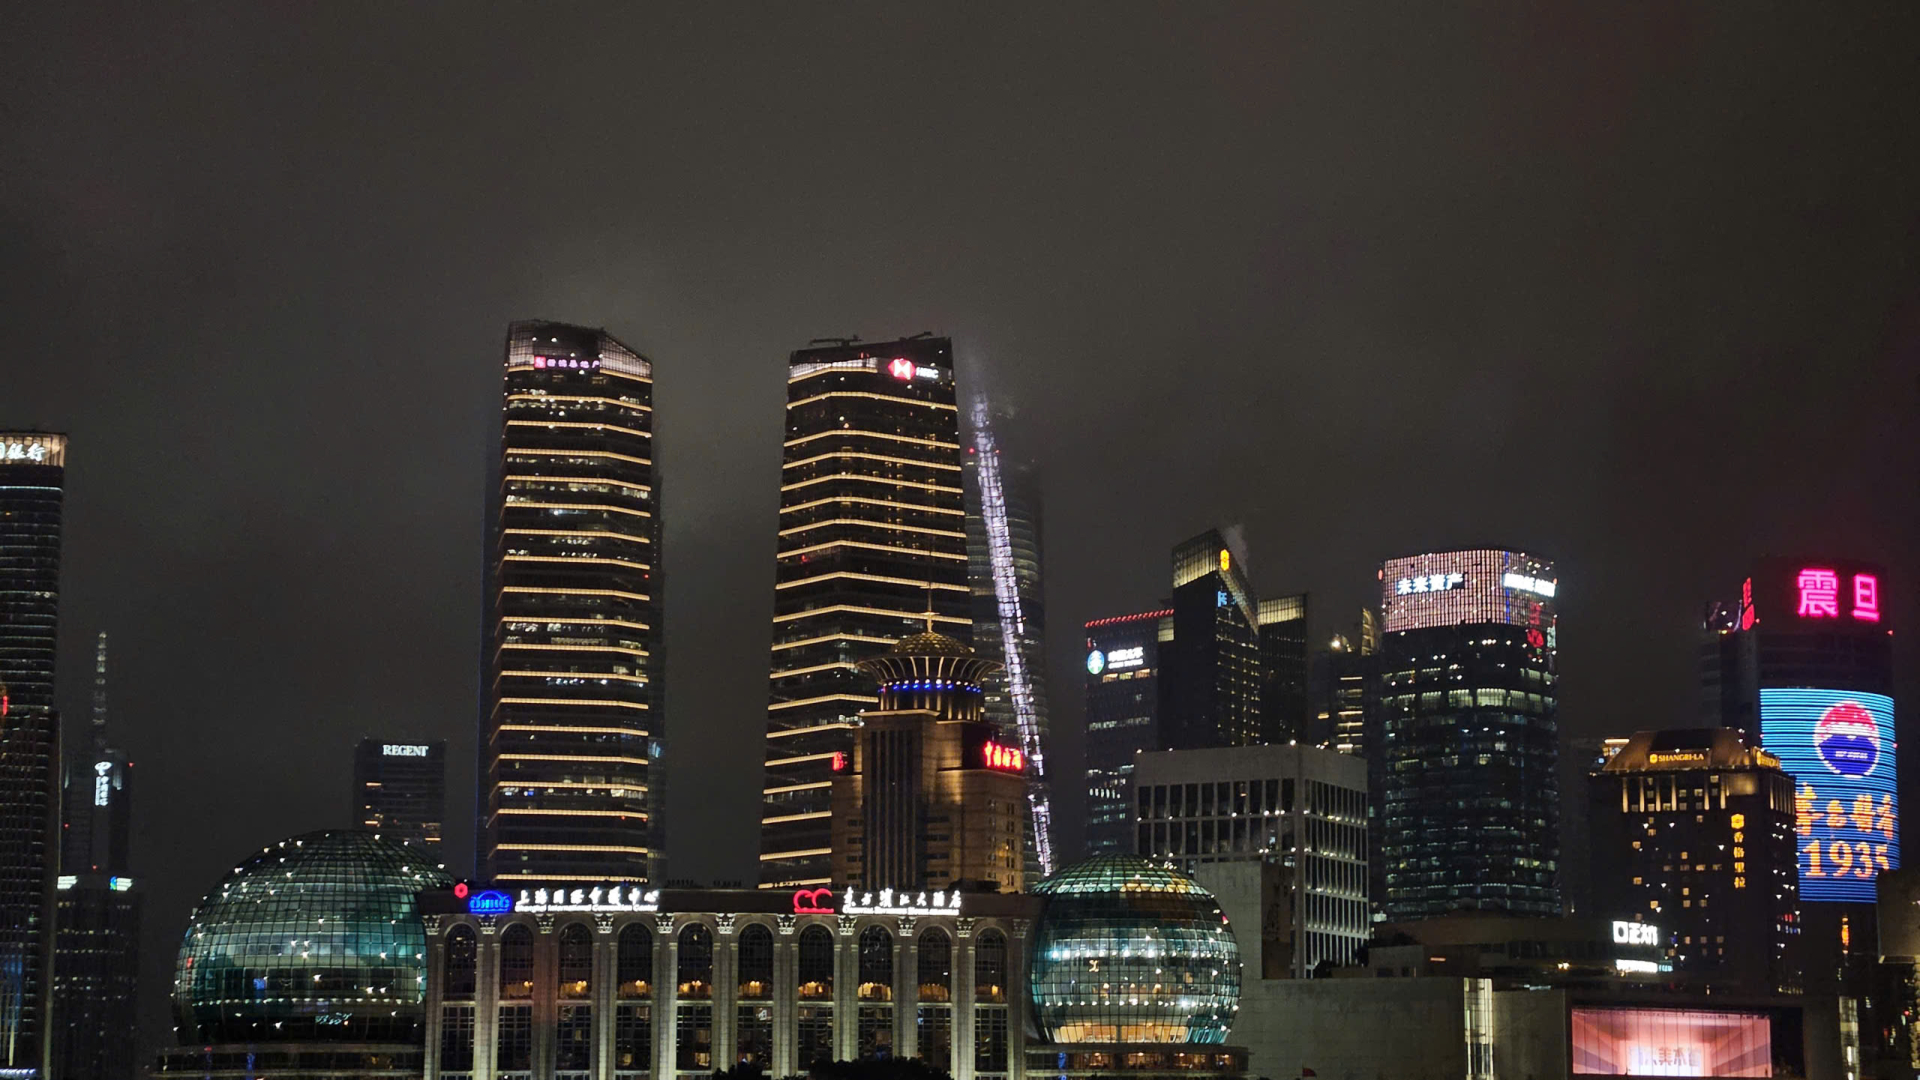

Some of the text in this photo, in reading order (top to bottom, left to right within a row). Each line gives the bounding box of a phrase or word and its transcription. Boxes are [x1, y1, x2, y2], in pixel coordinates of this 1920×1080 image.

[1798, 568, 1880, 621] 震旦
[382, 744, 430, 757] REGENT
[1658, 753, 1705, 763] SHANGRI-LA
[1733, 831, 1746, 889] 香格里拉
[547, 904, 592, 912] International
